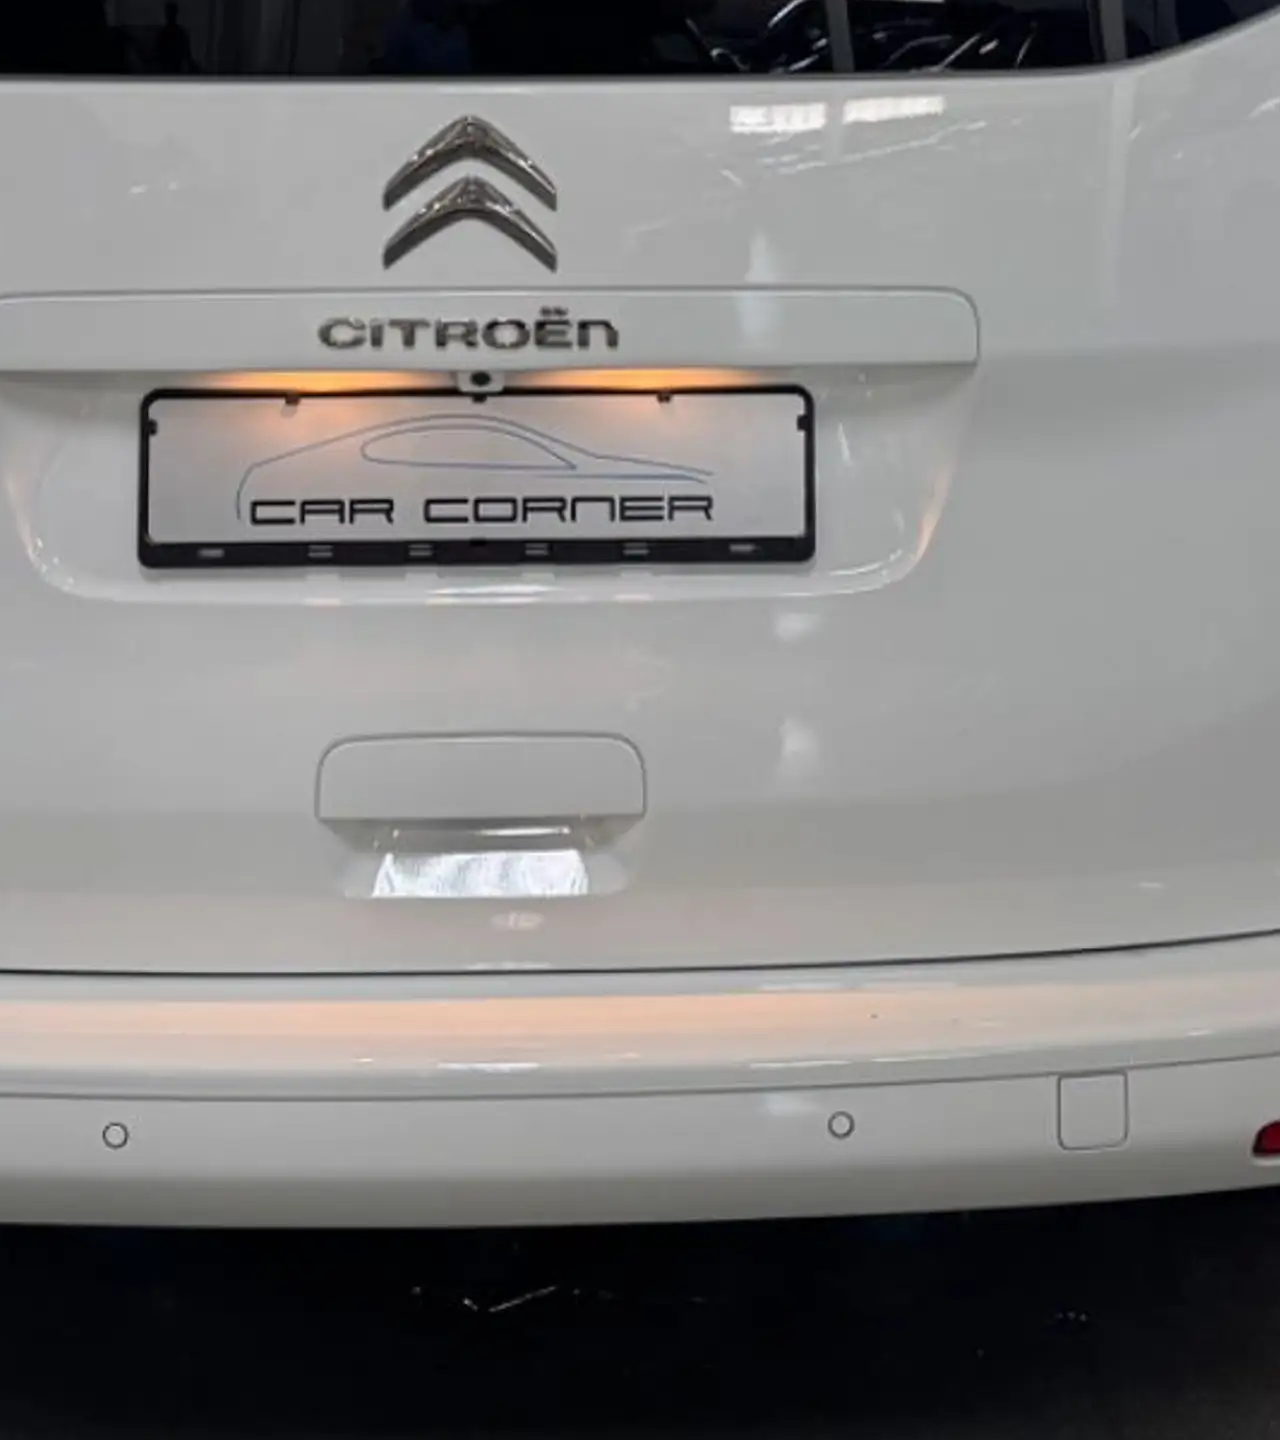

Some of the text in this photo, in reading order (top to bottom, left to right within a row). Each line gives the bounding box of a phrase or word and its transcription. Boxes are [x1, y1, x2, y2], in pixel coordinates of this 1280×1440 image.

[318, 306, 619, 350] CITROËN
[250, 495, 714, 526] CAR CORNER
